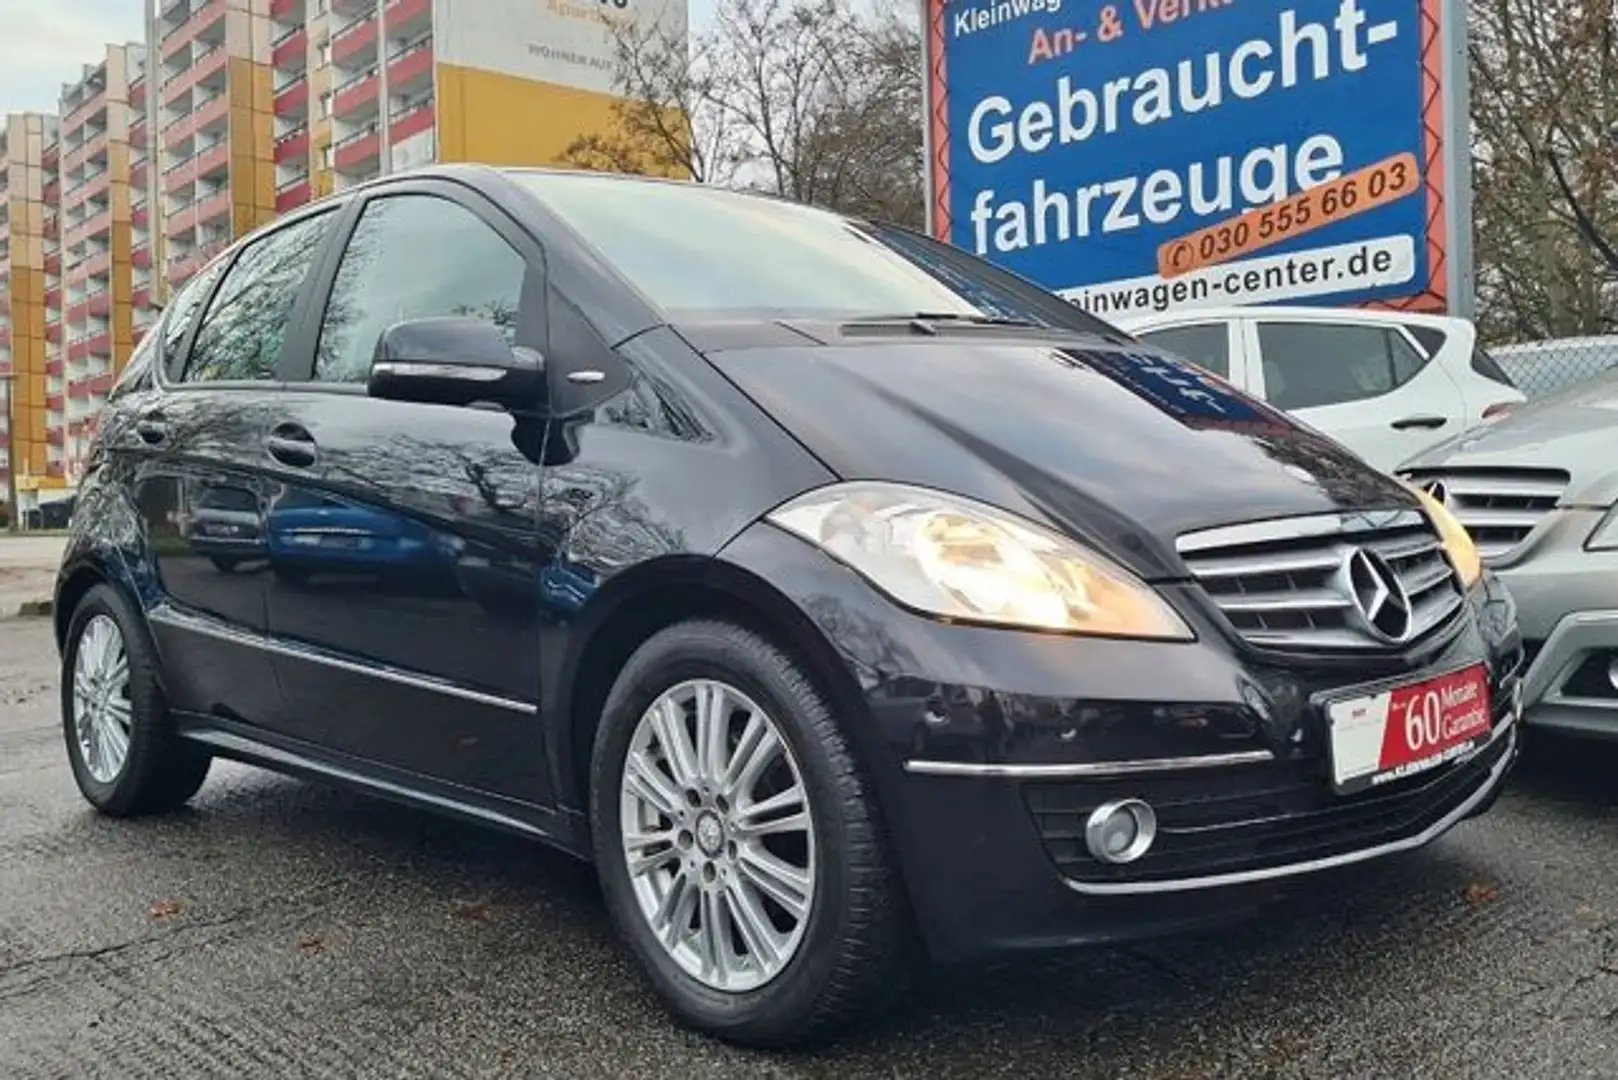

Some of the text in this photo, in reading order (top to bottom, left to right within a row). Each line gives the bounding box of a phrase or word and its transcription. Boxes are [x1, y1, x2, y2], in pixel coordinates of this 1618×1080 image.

[1027, 0, 1234, 64] An- & Ver
[967, 0, 1398, 164] Gebraucht-
[971, 132, 1344, 255] fahrzeuge
[1200, 161, 1407, 260] 030 555 66 03
[1405, 690, 1440, 751] 60
